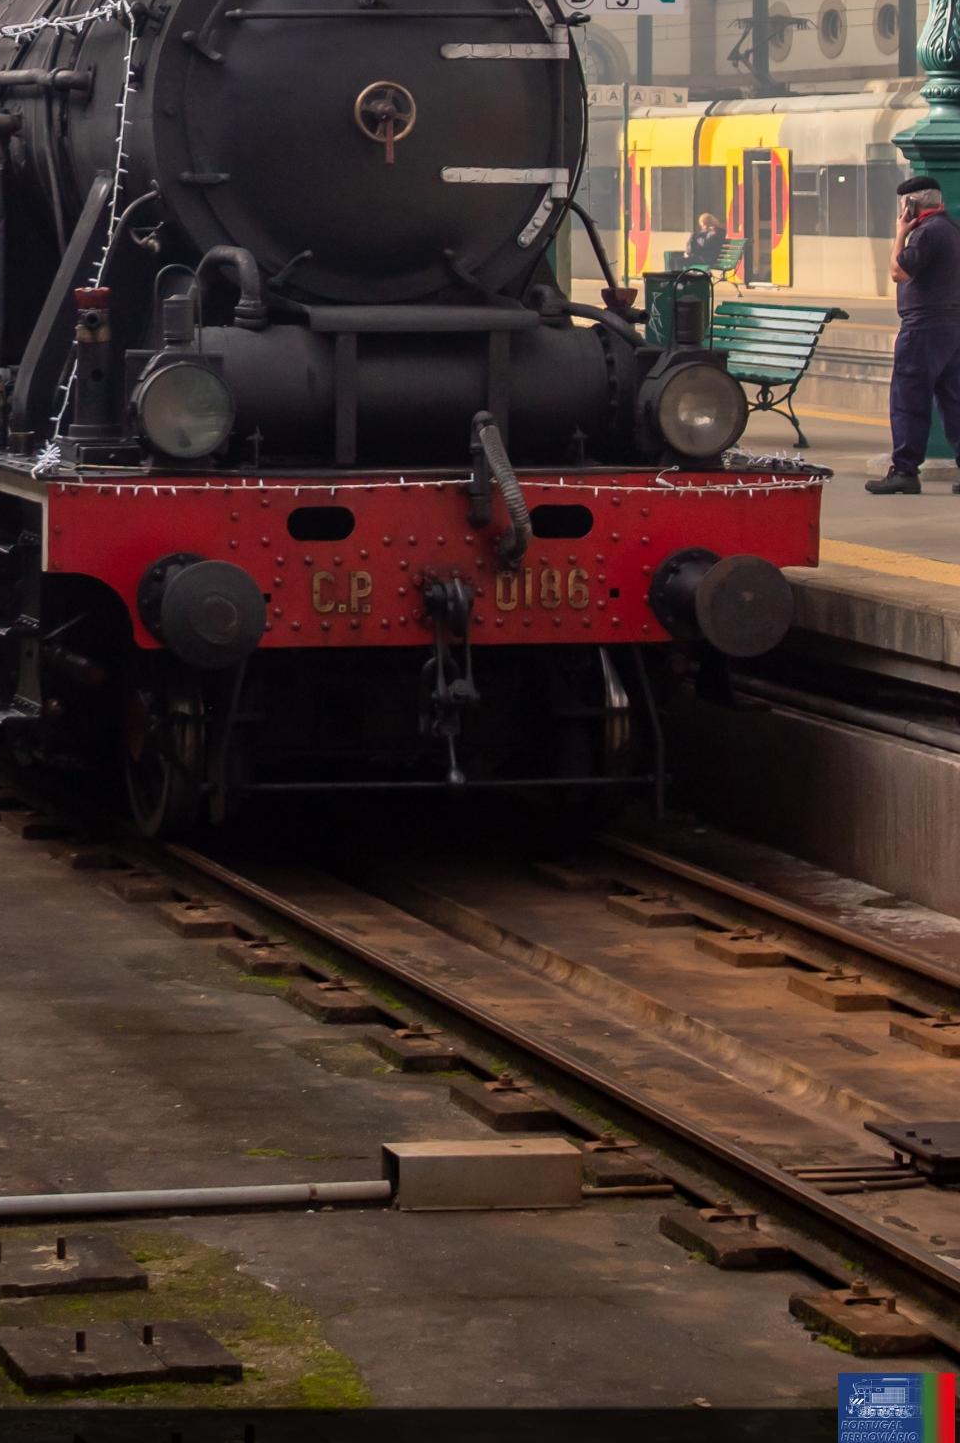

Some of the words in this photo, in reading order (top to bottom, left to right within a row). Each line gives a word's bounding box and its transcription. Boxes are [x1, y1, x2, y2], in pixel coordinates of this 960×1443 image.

[609, 91, 618, 101] A
[634, 91, 642, 101] A
[312, 571, 372, 613] C.P.
[496, 568, 589, 611] 0186
